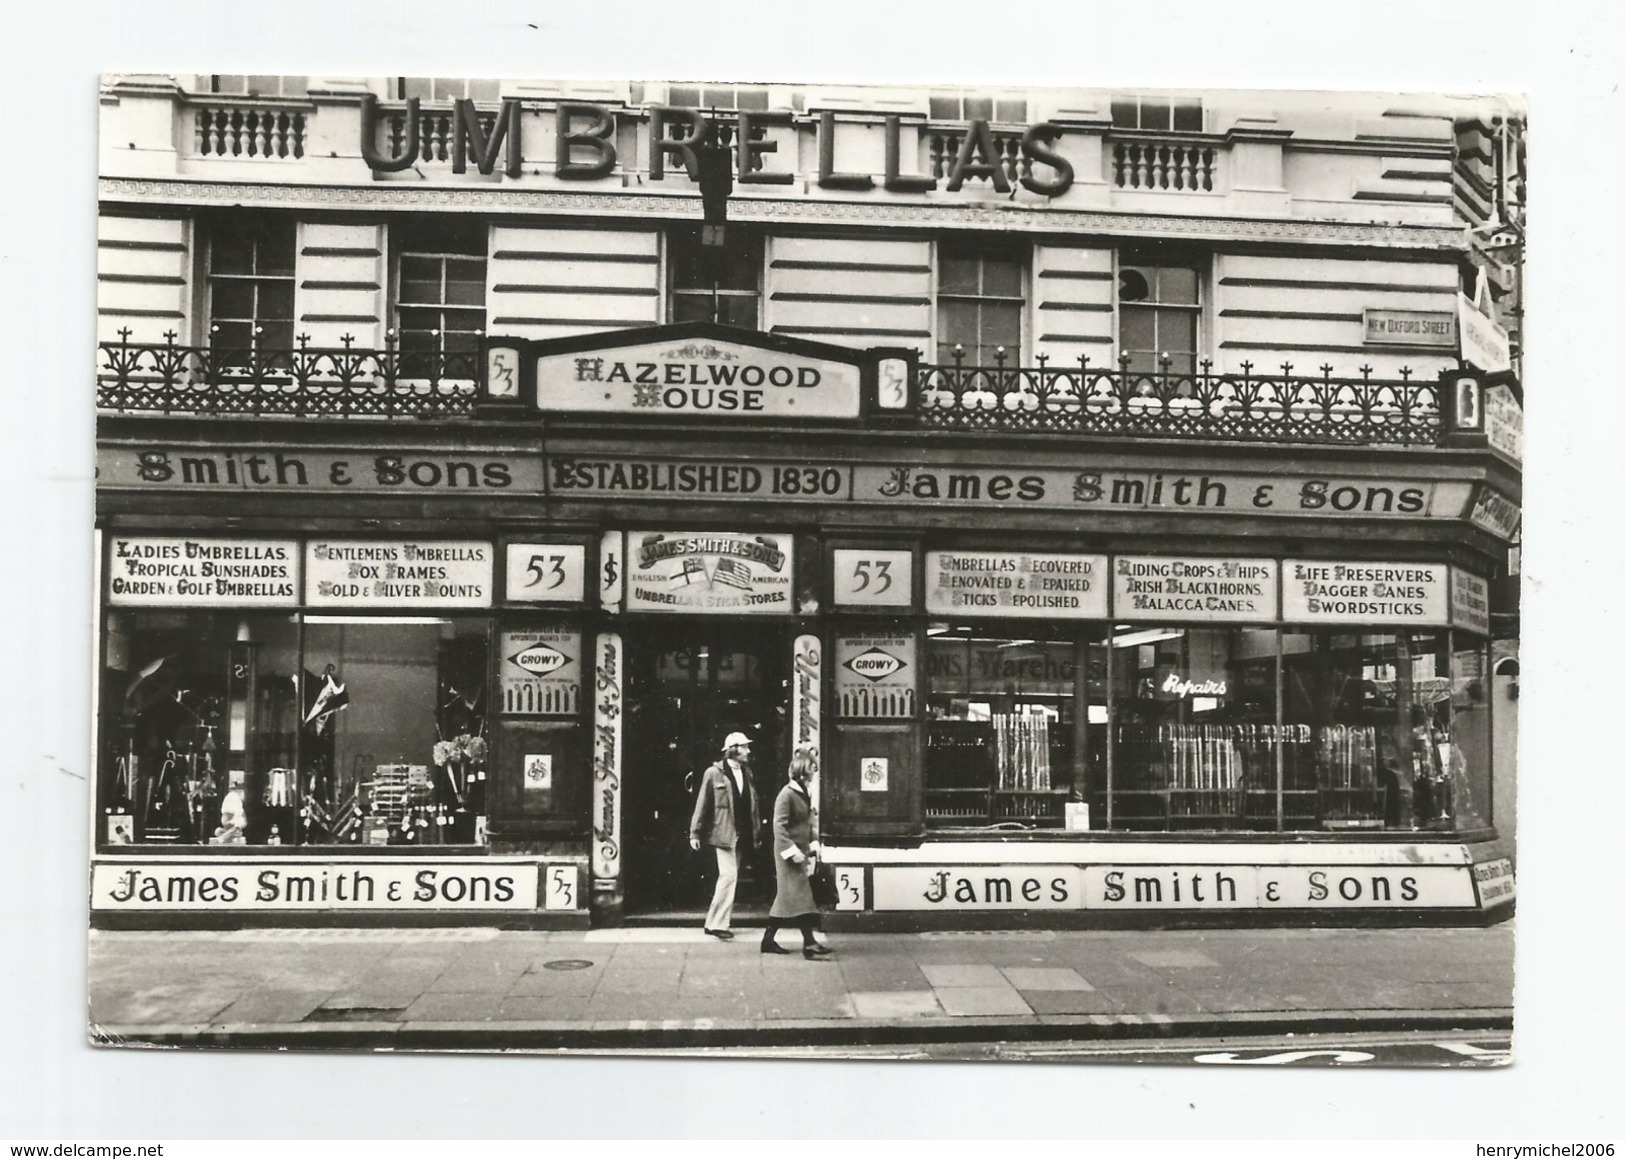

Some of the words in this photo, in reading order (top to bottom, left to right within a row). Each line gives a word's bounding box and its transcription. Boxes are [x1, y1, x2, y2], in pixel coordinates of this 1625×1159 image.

[361, 97, 1075, 197] UMBRELLAS
[1368, 319, 1386, 332] NEW
[1388, 319, 1420, 333] OXFORD
[1422, 320, 1450, 334] STREET
[493, 355, 513, 392] 53
[574, 358, 821, 388] HAZELWOOD
[884, 367, 902, 401] 53
[633, 384, 764, 411] HOUSE
[135, 451, 308, 485] Smith
[374, 455, 513, 488] Sons
[551, 459, 762, 495] ESTABLISHED
[772, 467, 841, 495] 1830
[877, 467, 1046, 501] James
[1073, 473, 1227, 507] Smith
[1299, 480, 1425, 513] Sons
[116, 541, 180, 559] LADIES
[185, 541, 289, 560] UMBRELLAS.
[314, 544, 398, 561] GENTLEMENS
[686, 538, 731, 554] SMITH
[731, 541, 740, 554] &
[125, 559, 197, 577] TROPICAL
[201, 561, 290, 578] SUNSHADES.
[525, 555, 567, 589] 53
[938, 554, 1016, 571] UMBRELLAS
[1117, 559, 1170, 577] RIDING
[1171, 561, 1215, 578] CROPS
[1295, 564, 1330, 581] LIFE
[1334, 565, 1437, 583] PRESERVERS.
[112, 577, 165, 595] GARDEN
[177, 578, 213, 595] GOLF
[632, 574, 668, 582] ENGLISH
[852, 561, 893, 595] 53
[938, 571, 1012, 589] RENOVATED
[1126, 577, 1163, 593] IRISH
[1303, 581, 1368, 598] DAGGER
[1372, 583, 1429, 599] CANES.
[635, 588, 692, 606] UMBRELLA
[1132, 594, 1203, 611] MALACCA
[1307, 598, 1427, 615] SWORDSTICKS.
[597, 643, 620, 701] Sons
[1162, 673, 1227, 699] Repairs
[595, 725, 618, 790] Smith
[109, 870, 239, 903] James
[255, 870, 375, 902] Smith
[414, 870, 515, 902] Sons
[553, 870, 574, 906] 53
[840, 874, 860, 904] 53
[923, 869, 1069, 903] James
[1103, 870, 1238, 903] Smith
[1307, 870, 1420, 903] Sons
